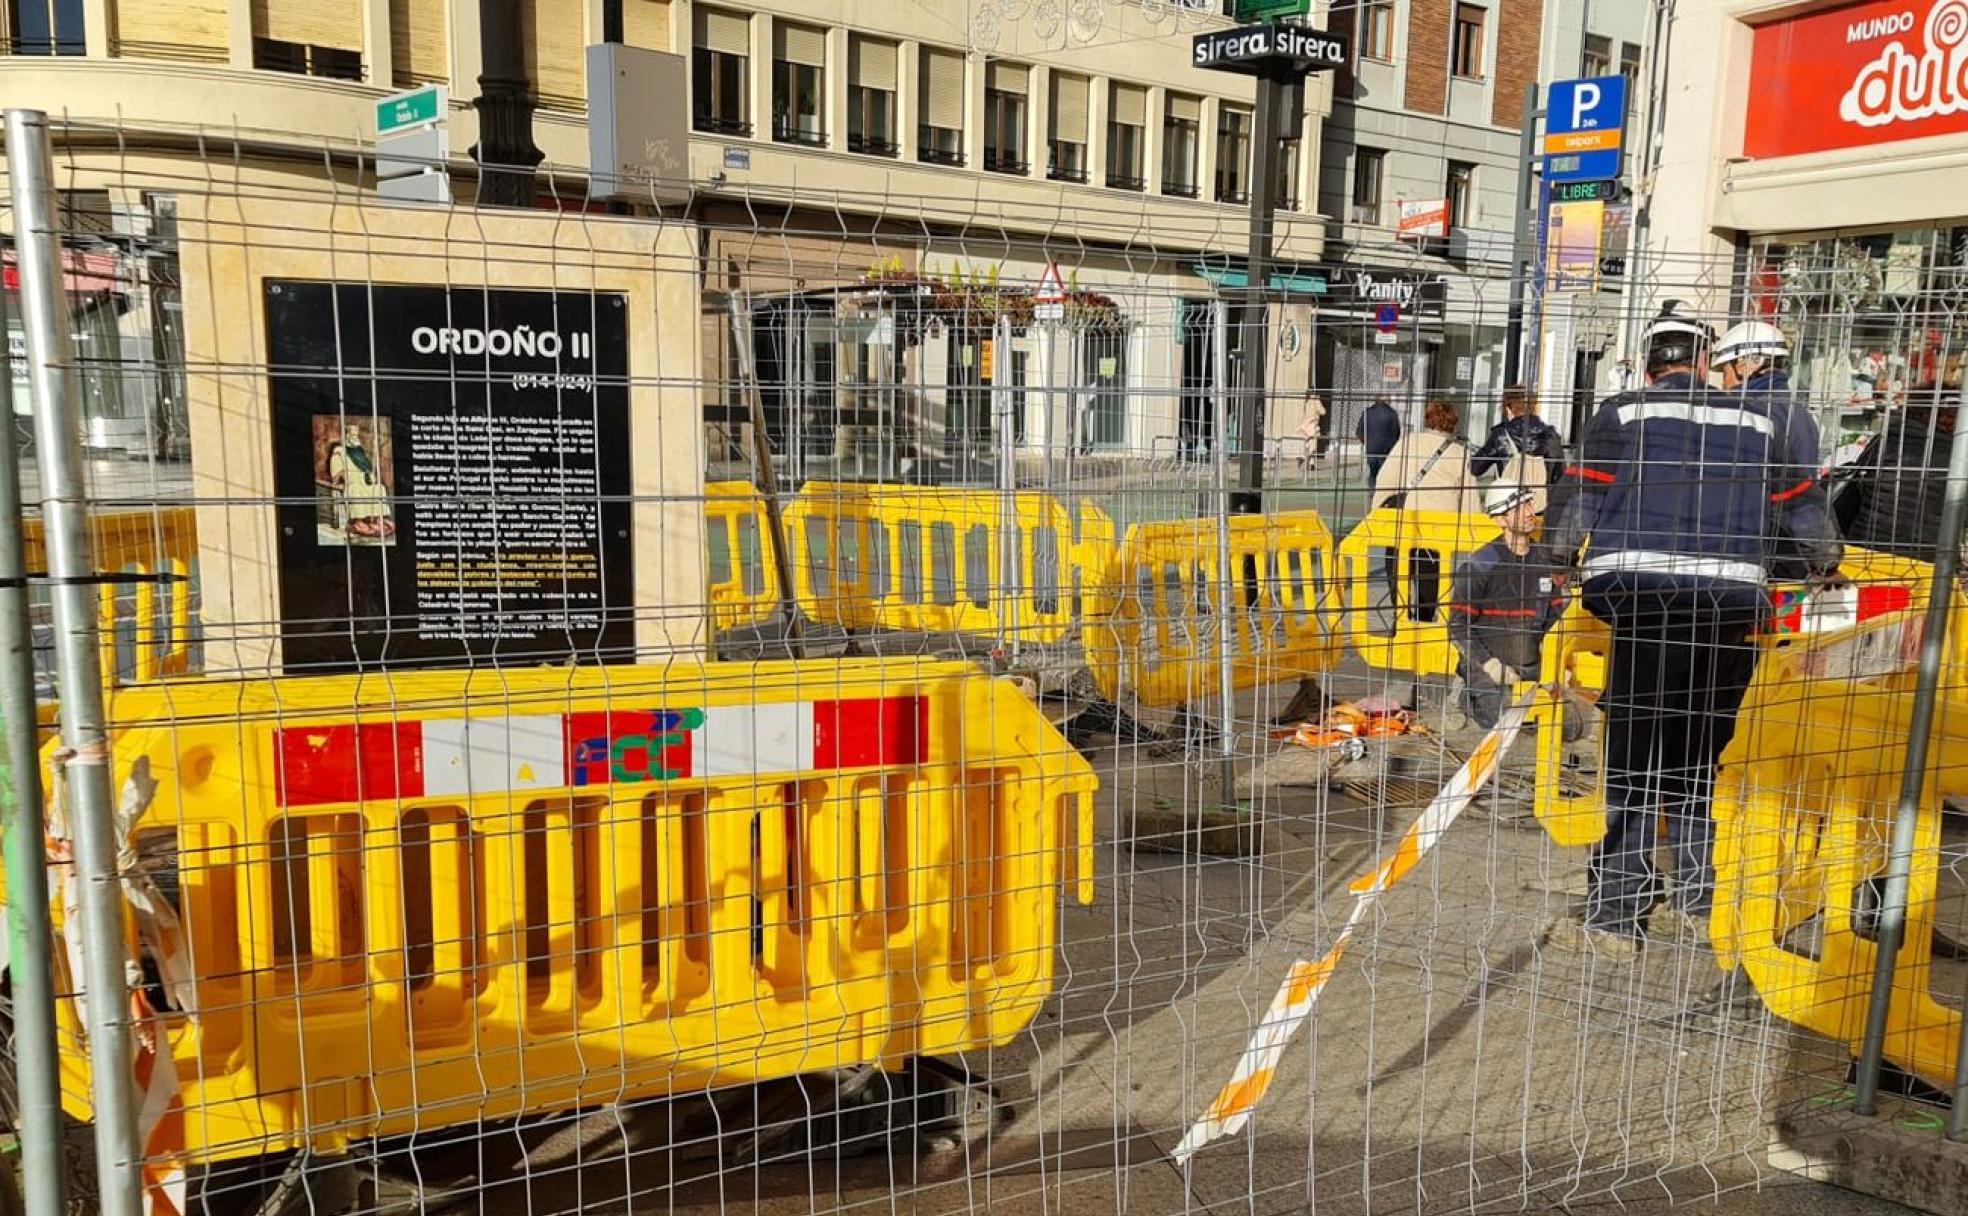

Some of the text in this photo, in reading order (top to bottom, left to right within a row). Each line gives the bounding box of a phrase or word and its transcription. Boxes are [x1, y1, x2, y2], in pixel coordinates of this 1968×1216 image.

[1847, 12, 1914, 43] MUNDO
[1195, 33, 1269, 62] sirera
[1276, 29, 1344, 62] sirera
[1571, 83, 1600, 129] P
[1583, 118, 1598, 127] 24h
[1562, 183, 1597, 199] LIBRE
[1356, 273, 1413, 308] Vanity
[411, 325, 590, 359] ORDOÑO II
[575, 733, 684, 786] FCC
